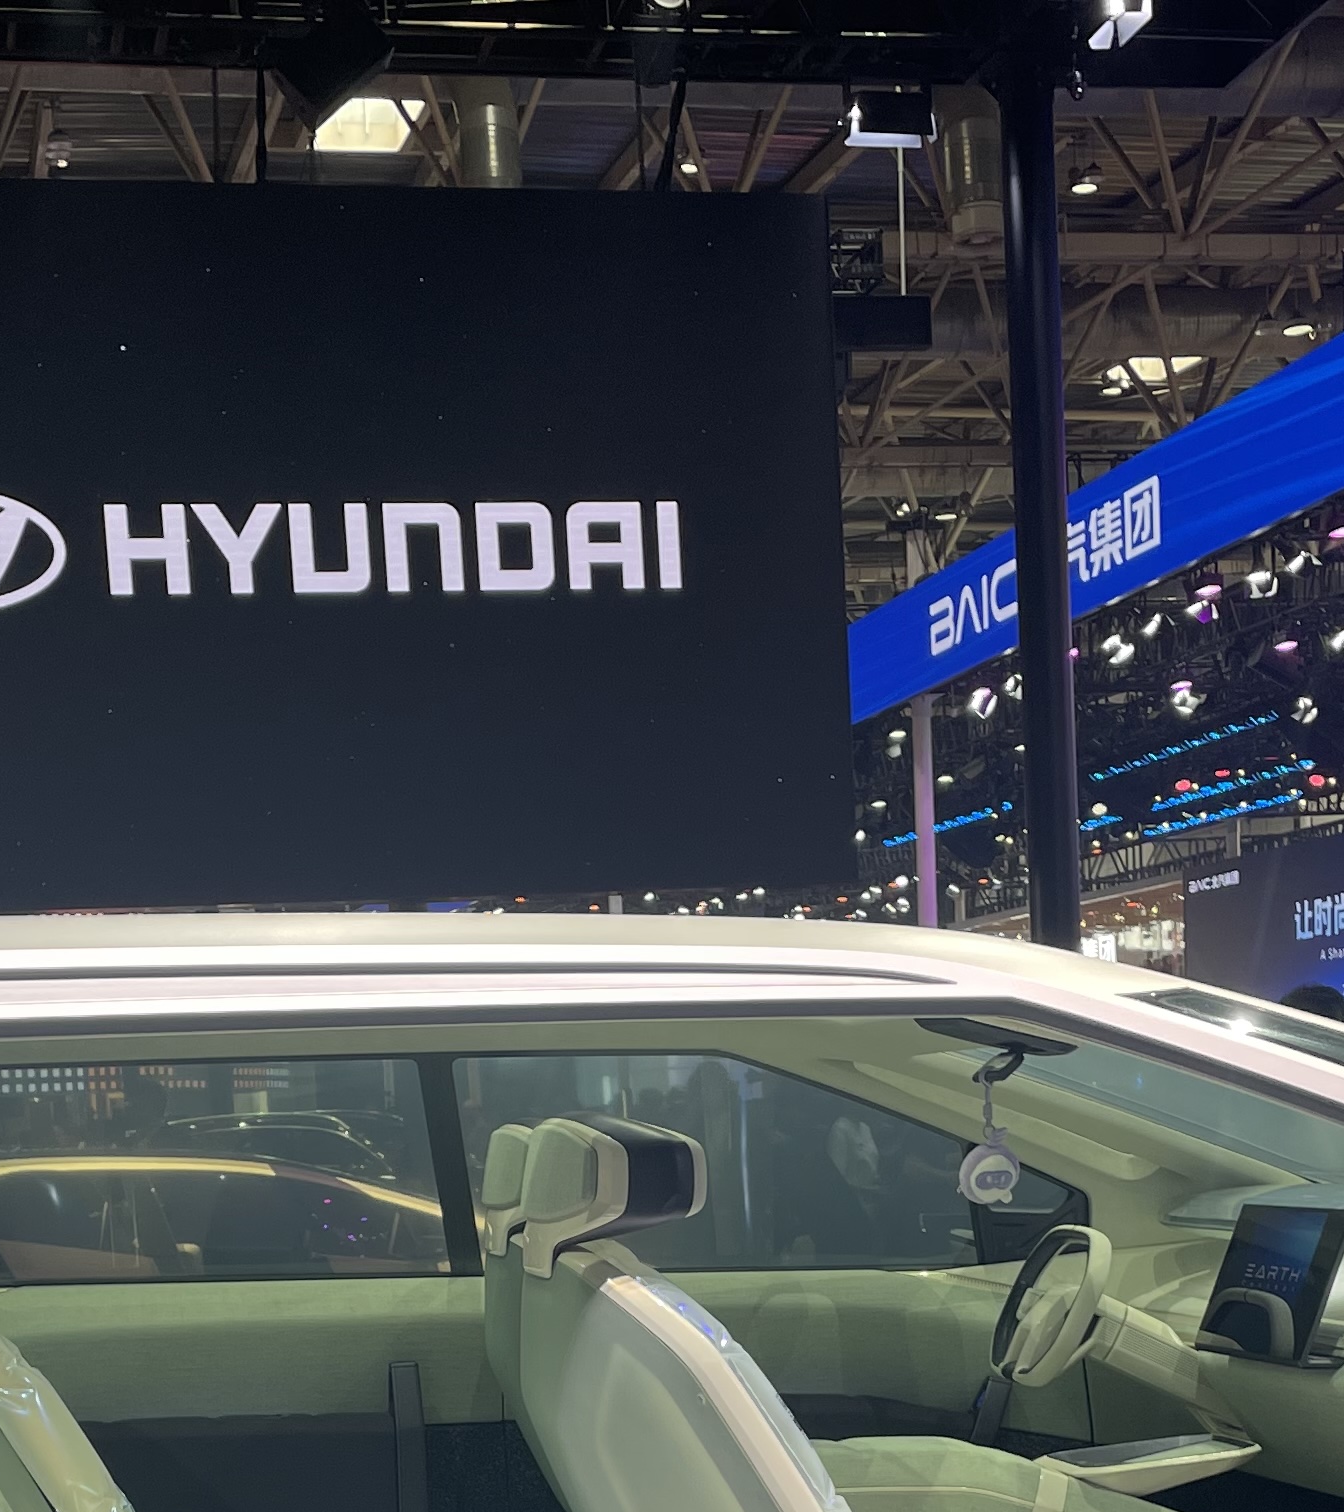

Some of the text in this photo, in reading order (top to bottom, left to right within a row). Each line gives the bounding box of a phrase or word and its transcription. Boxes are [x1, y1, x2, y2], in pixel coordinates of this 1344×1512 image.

[103, 500, 684, 595] HYUNDAI
[929, 558, 1018, 657] BAIC
[1320, 948, 1327, 961] A
[1244, 1263, 1302, 1282] EARTH
